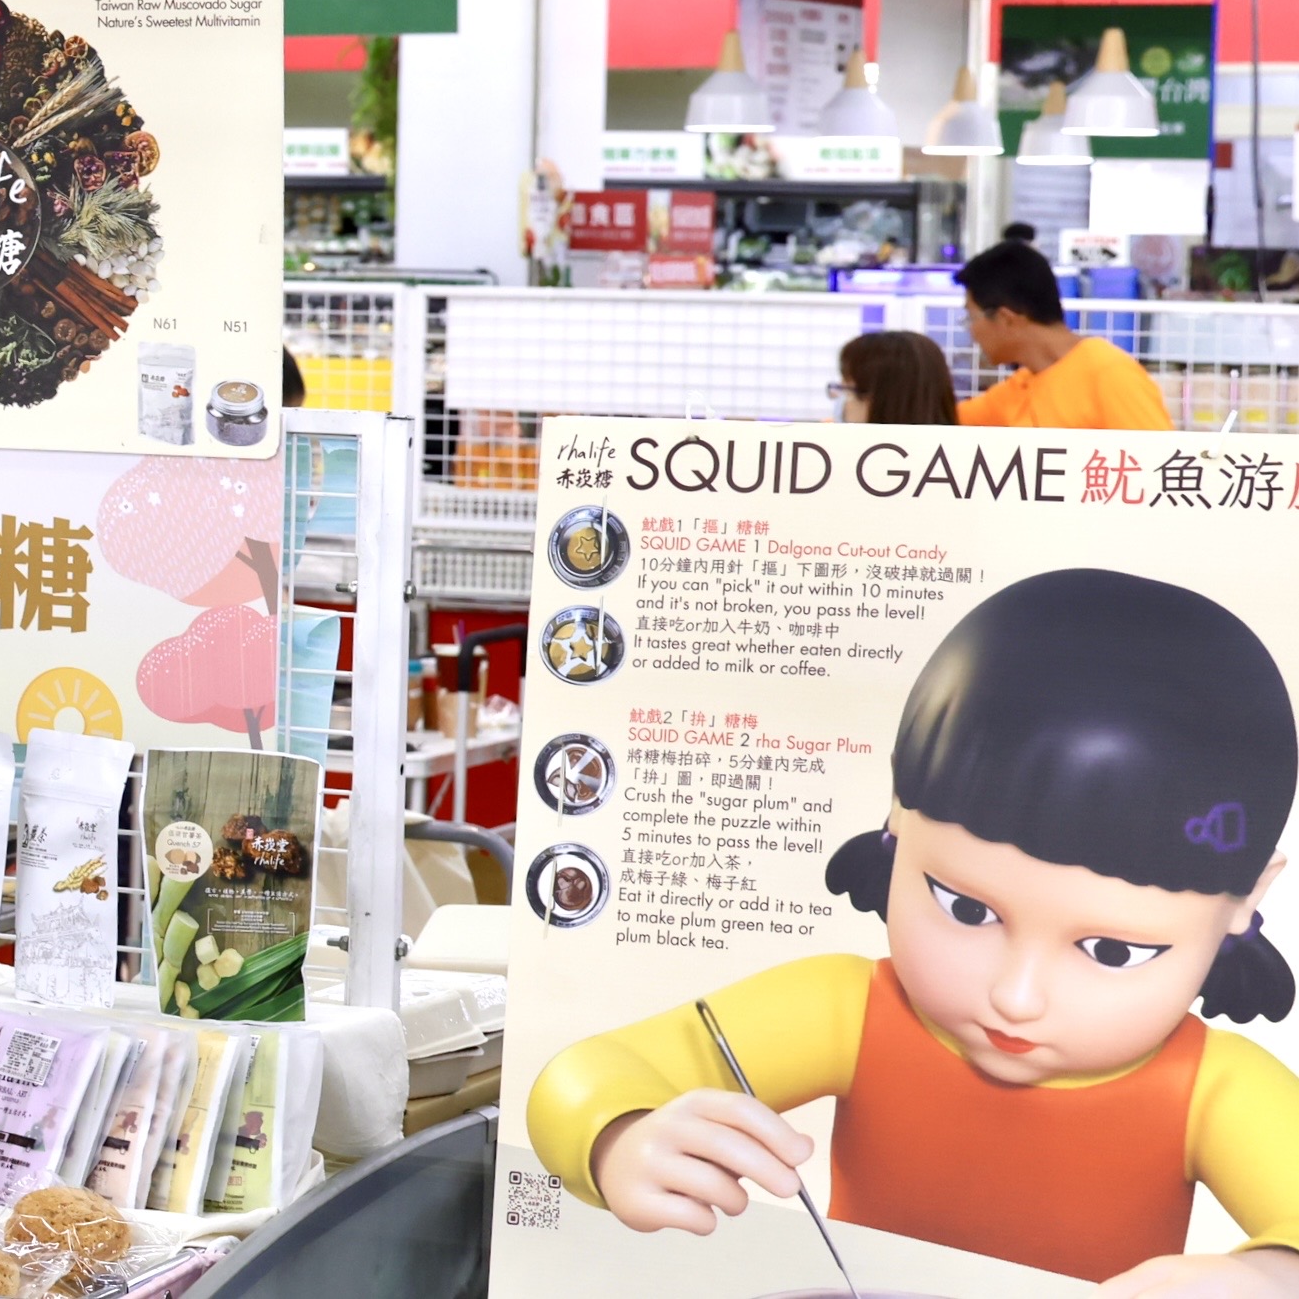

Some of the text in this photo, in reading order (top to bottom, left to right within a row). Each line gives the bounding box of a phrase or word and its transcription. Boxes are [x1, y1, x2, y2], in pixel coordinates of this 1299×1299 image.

[95, 0, 134, 11] Taiwan
[138, 0, 160, 10] Raw
[97, 14, 261, 28] Nature's Sweetest Multivitamin
[153, 318, 177, 329] N61
[224, 321, 247, 332] N51
[557, 434, 617, 468] rhalife
[556, 468, 614, 489] 赤崁糖
[626, 437, 1299, 511] SQUID GAME 魷魚游
[640, 536, 947, 564] SQUID GAME Dalgona Cut-out Candy
[716, 578, 944, 600] "pick" within minutes
[670, 597, 925, 620] it's broken, pass level!
[647, 637, 903, 663] tastes great whether eaten directly
[653, 655, 830, 677] added milk coffee.
[628, 727, 872, 755] SQUID GAME Sugar Plum
[624, 787, 796, 812] Crush "sugar plum"
[623, 808, 821, 833] complete puzzle within
[638, 830, 823, 853] minutes pass level!
[660, 890, 713, 910] directly
[637, 909, 764, 933] make plum green
[616, 927, 729, 949] plum black tea.
